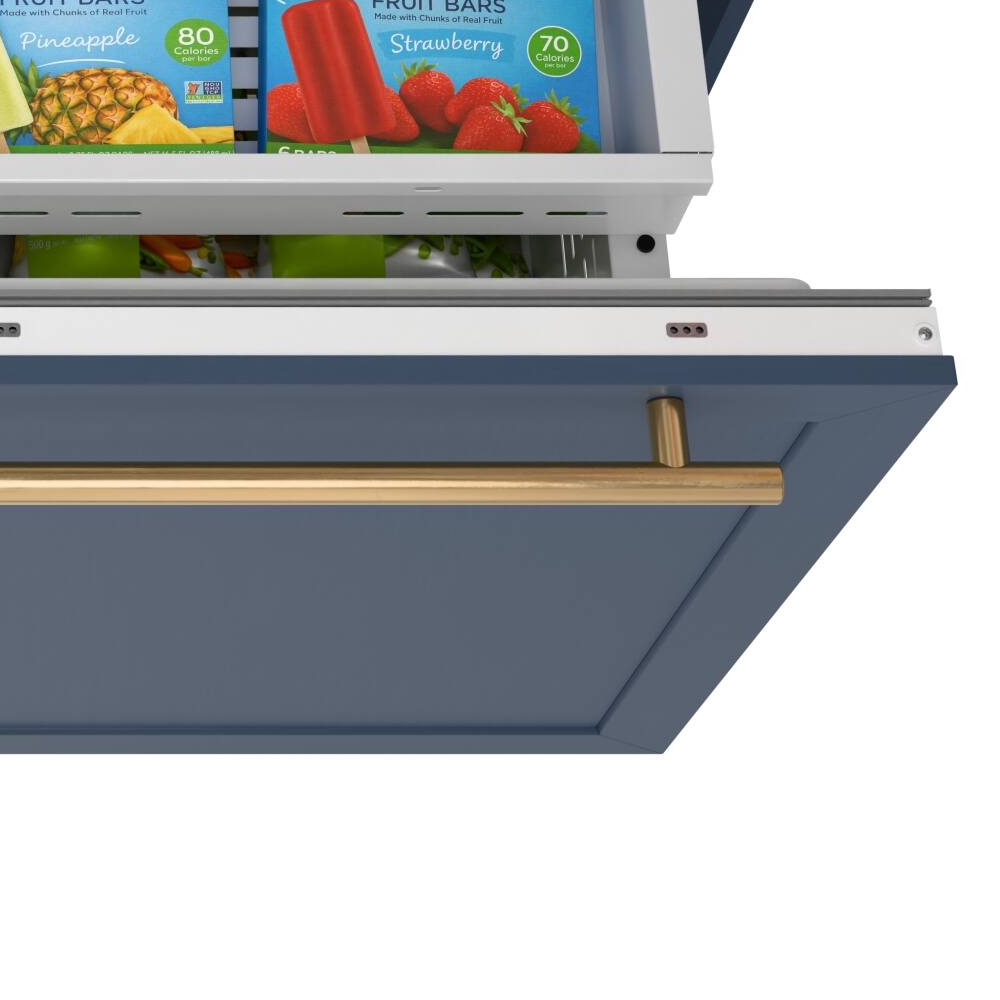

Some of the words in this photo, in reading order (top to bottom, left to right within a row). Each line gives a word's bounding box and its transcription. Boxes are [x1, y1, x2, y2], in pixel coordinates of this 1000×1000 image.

[0, 8, 27, 17] Made
[29, 8, 50, 17] with
[52, 8, 87, 17] Chunks
[89, 7, 101, 17] of
[102, 7, 123, 17] Real
[125, 7, 148, 17] Fruit
[374, 13, 397, 22] Made
[399, 13, 417, 22] with
[419, 14, 451, 24] Chunks
[452, 15, 461, 23] of
[463, 15, 482, 24] Real
[484, 16, 503, 25] Fruit
[19, 26, 140, 53] Pineapple
[178, 27, 214, 46] 80
[540, 35, 569, 53] 70
[174, 46, 219, 56] Calories
[390, 32, 504, 60] Strawberry
[535, 53, 575, 63] Calories
